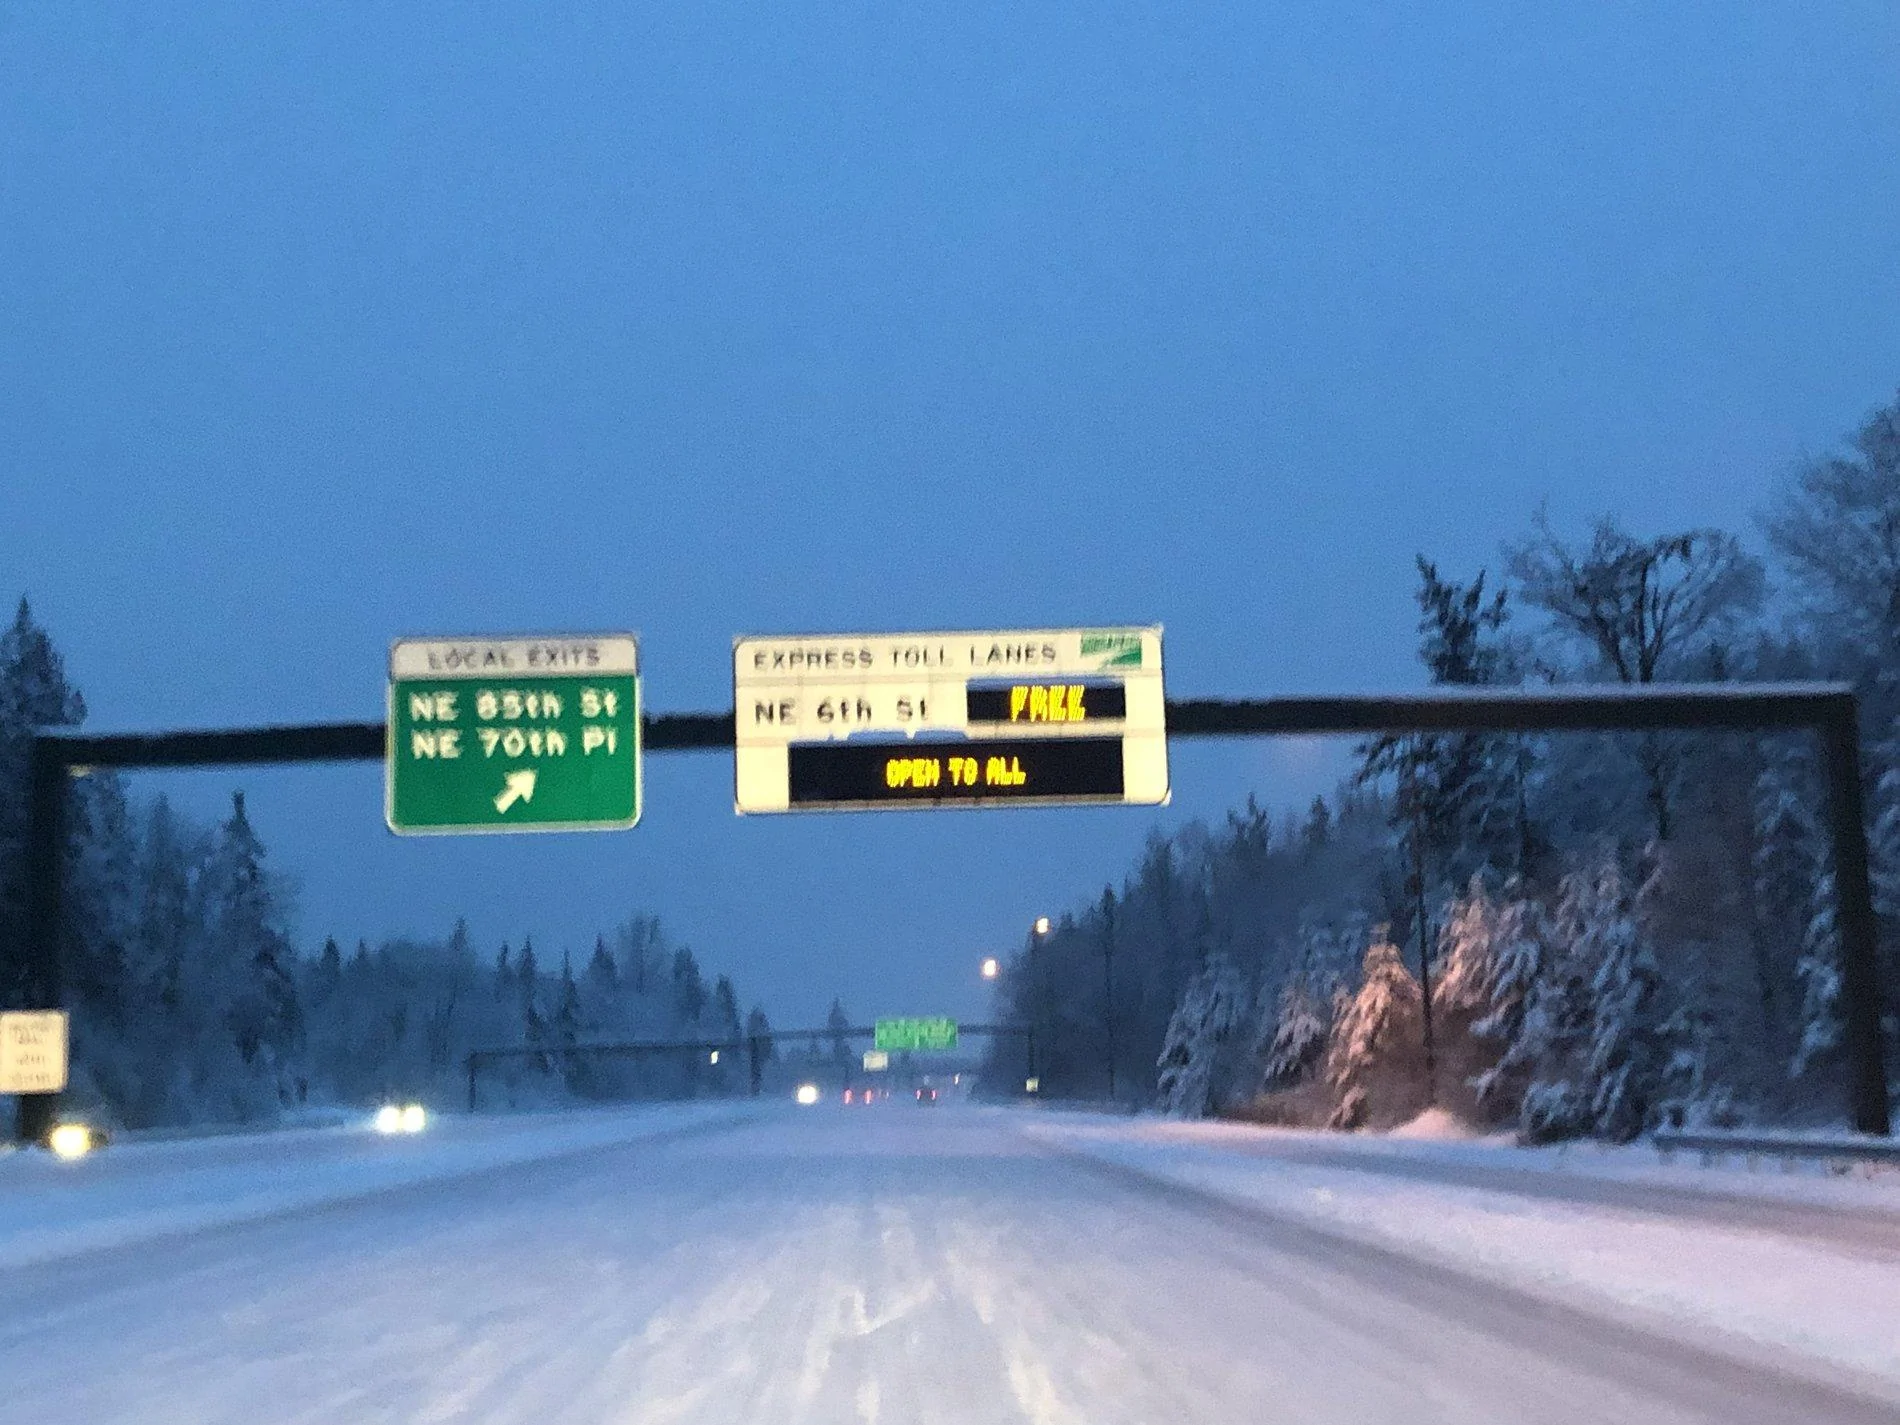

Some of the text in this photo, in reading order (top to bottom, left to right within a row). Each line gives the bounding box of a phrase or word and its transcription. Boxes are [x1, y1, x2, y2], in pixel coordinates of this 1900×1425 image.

[428, 645, 601, 670] LOCAL EXITS
[754, 642, 1057, 670] EXPRESS TOLL LANES
[409, 690, 462, 722] NE
[579, 686, 619, 719] St
[754, 695, 928, 725] NE 6th St
[1011, 684, 1086, 722] FREE
[411, 724, 617, 760] NE 70th Pl
[886, 756, 1027, 788] OPEN TO ALL
